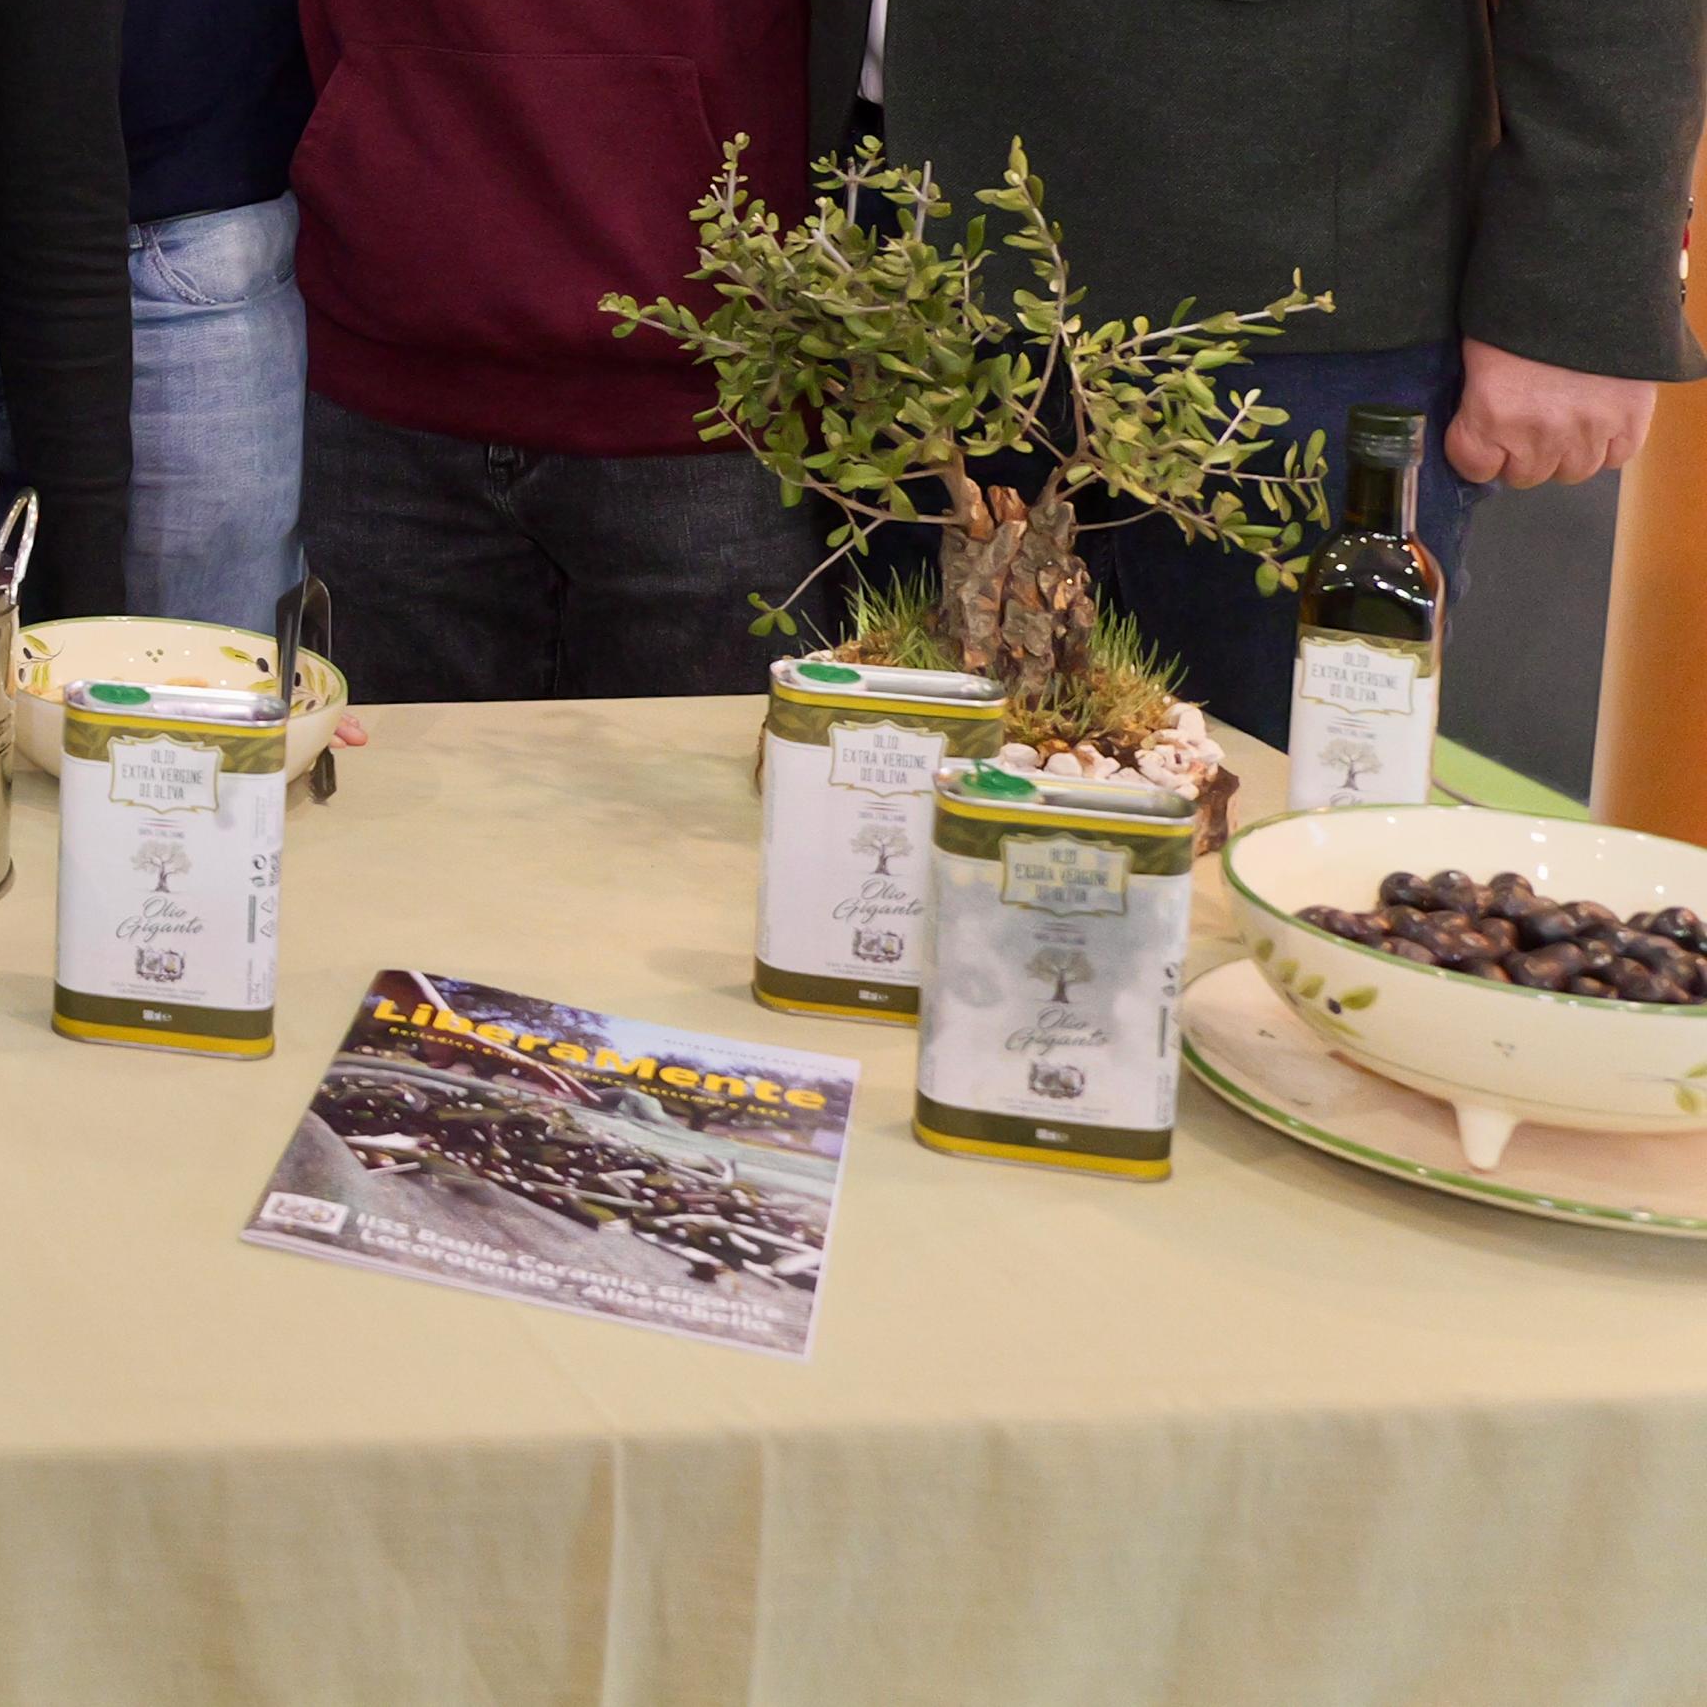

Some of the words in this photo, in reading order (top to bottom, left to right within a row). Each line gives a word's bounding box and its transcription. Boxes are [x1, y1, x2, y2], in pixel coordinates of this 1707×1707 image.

[874, 734, 899, 750] OLIO
[151, 749, 175, 764] OLIO
[842, 748, 877, 765] EXTRA
[882, 753, 927, 769] VERGINE
[122, 764, 155, 780] EXTRA
[159, 768, 203, 785] VERGINE
[861, 878, 906, 900] Olio
[142, 895, 187, 918] Olio
[832, 897, 924, 924] Gigante
[115, 916, 204, 942] Gigante
[373, 999, 828, 1110] LiberaMente
[356, 1212, 410, 1237] IISS
[417, 1228, 509, 1263] Basile
[517, 1251, 649, 1295] Caramia
[360, 1228, 559, 1290] Locorotondo
[581, 1284, 774, 1332] Alberobello
